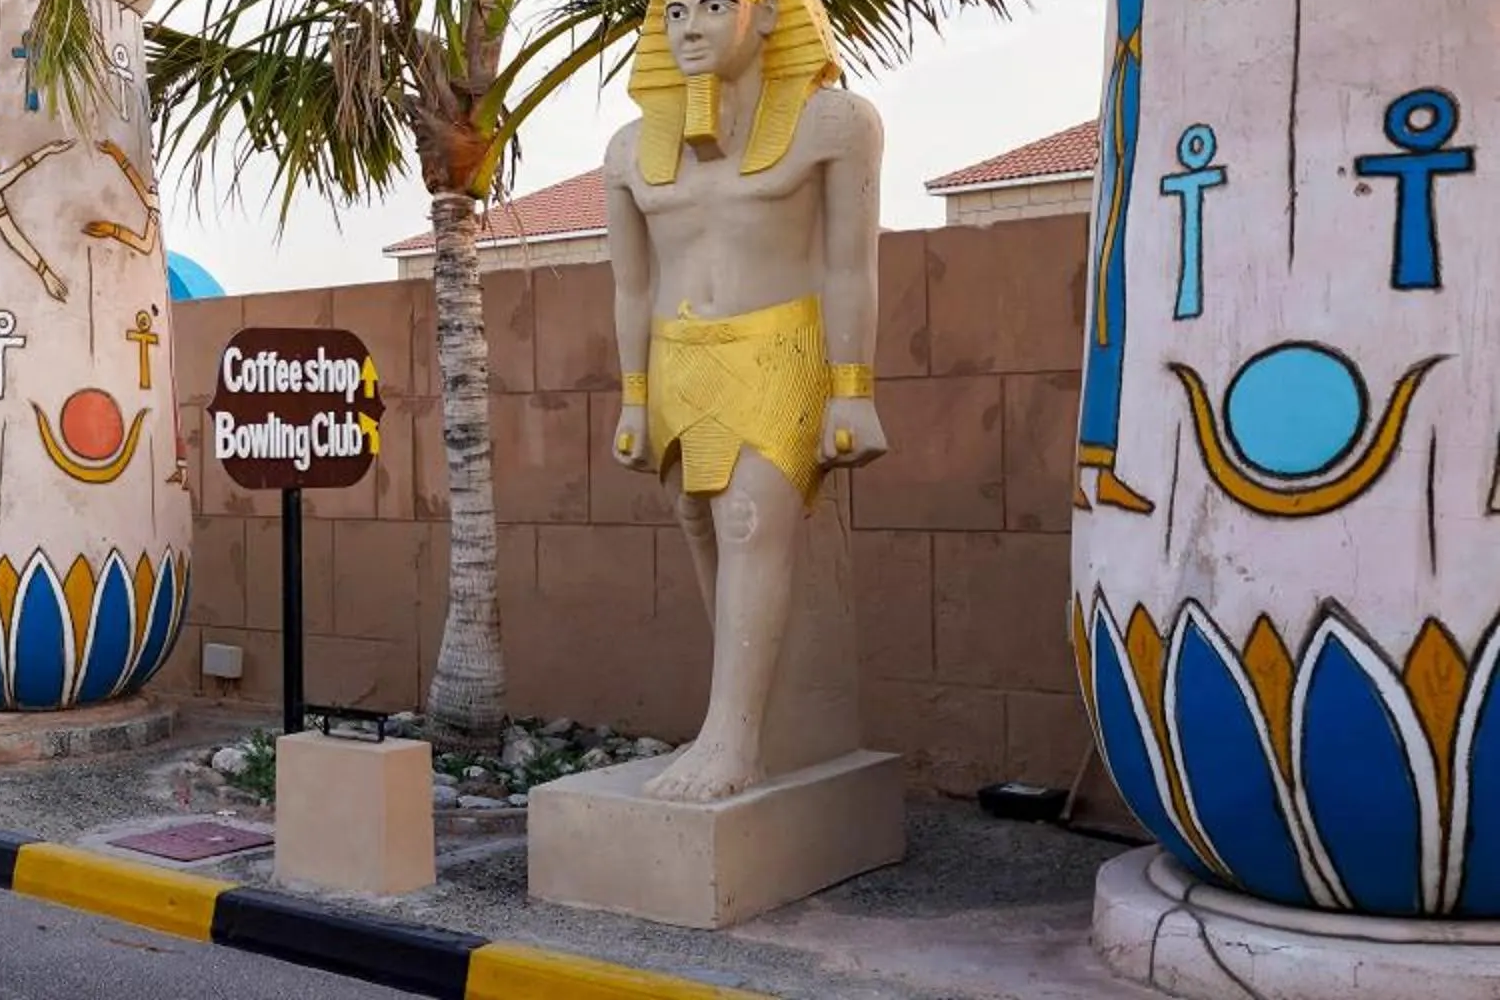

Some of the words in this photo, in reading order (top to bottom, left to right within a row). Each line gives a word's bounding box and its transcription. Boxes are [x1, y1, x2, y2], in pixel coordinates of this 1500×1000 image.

[223, 346, 302, 393] Coffee
[304, 347, 360, 403] shop
[215, 411, 311, 471] Bowling
[311, 411, 363, 457] Club
